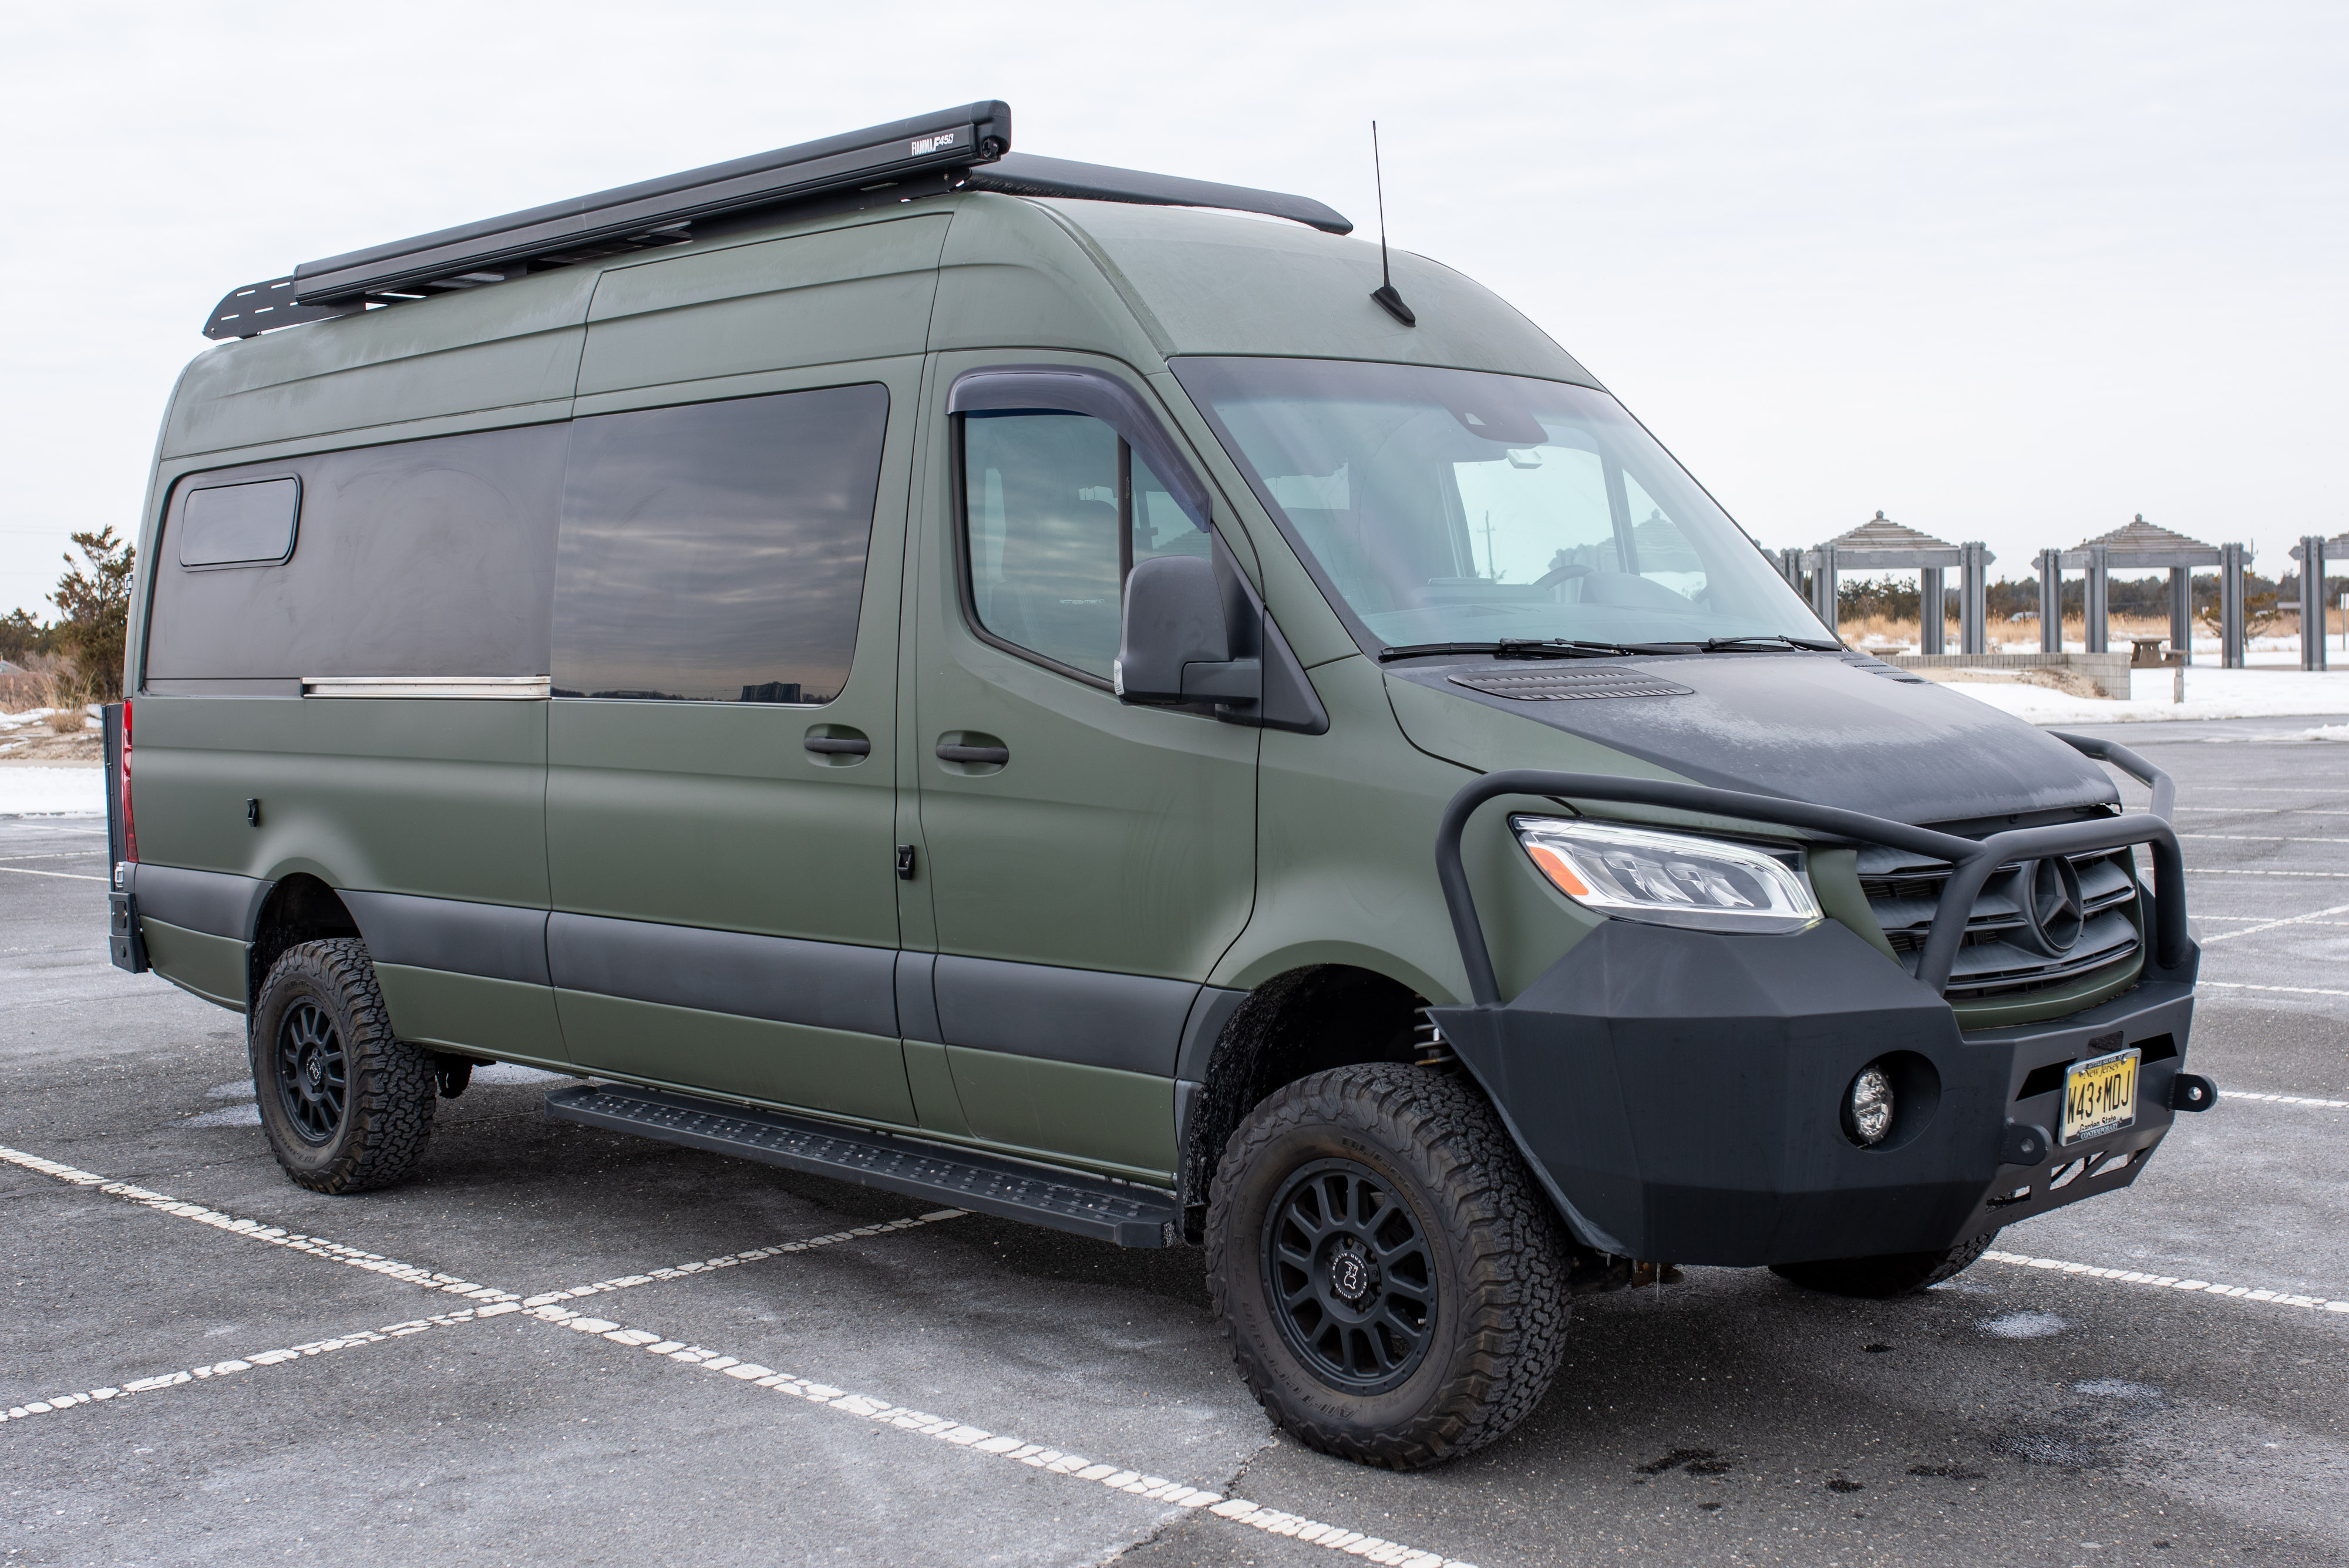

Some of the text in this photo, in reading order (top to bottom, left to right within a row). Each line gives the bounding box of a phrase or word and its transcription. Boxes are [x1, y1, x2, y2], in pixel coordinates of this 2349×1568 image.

[911, 138, 933, 156] FIAMMA
[2099, 1062, 2120, 1077] Jersey
[2068, 1071, 2131, 1124] W43 MDJ
[2081, 1115, 2116, 1131] Garden State
